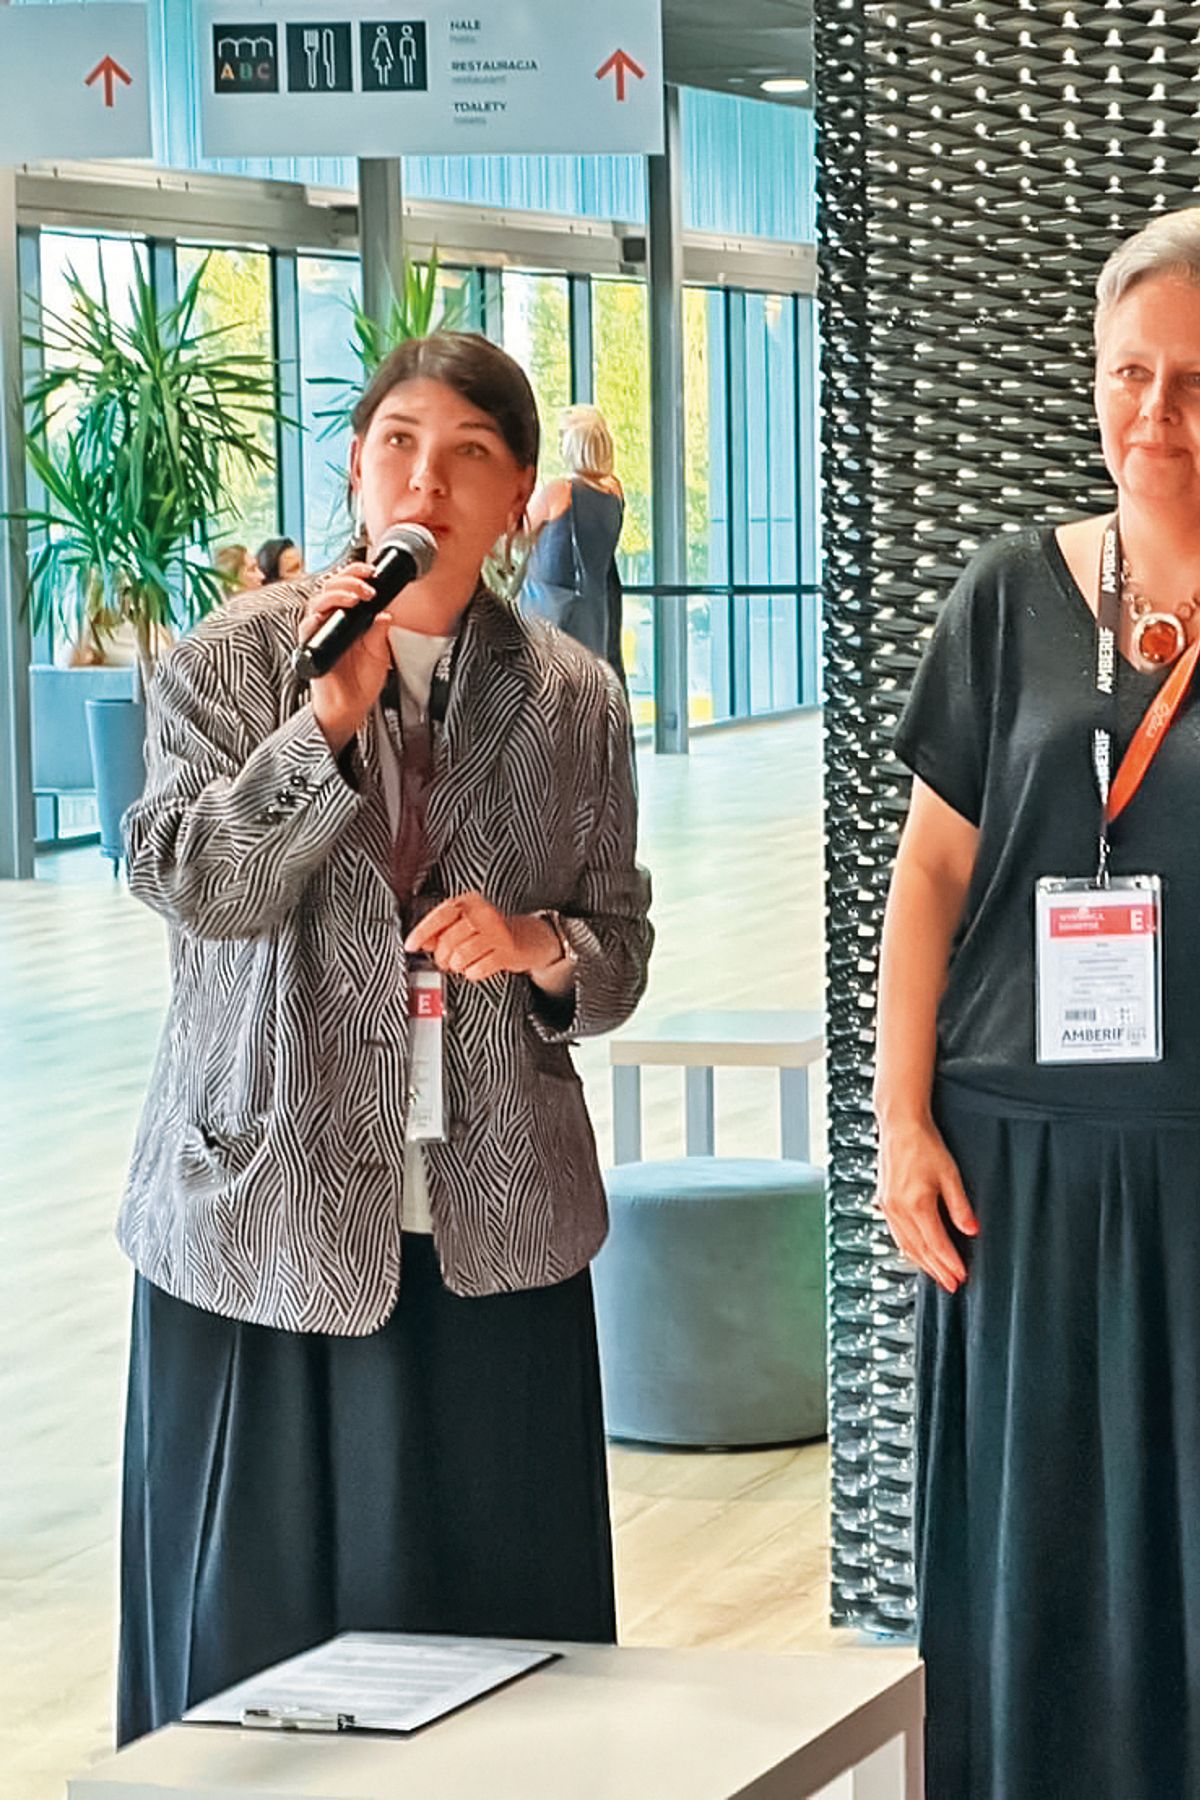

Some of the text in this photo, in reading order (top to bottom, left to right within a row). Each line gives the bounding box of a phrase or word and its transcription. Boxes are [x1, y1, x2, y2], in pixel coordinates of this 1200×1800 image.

[451, 60, 538, 71] RESTAURACJA
[454, 101, 507, 112] TOALETY
[1097, 626, 1114, 694] AMBERIF
[1130, 909, 1144, 931] E
[418, 994, 432, 1014] E
[1062, 1028, 1124, 1041] AMBERIF
